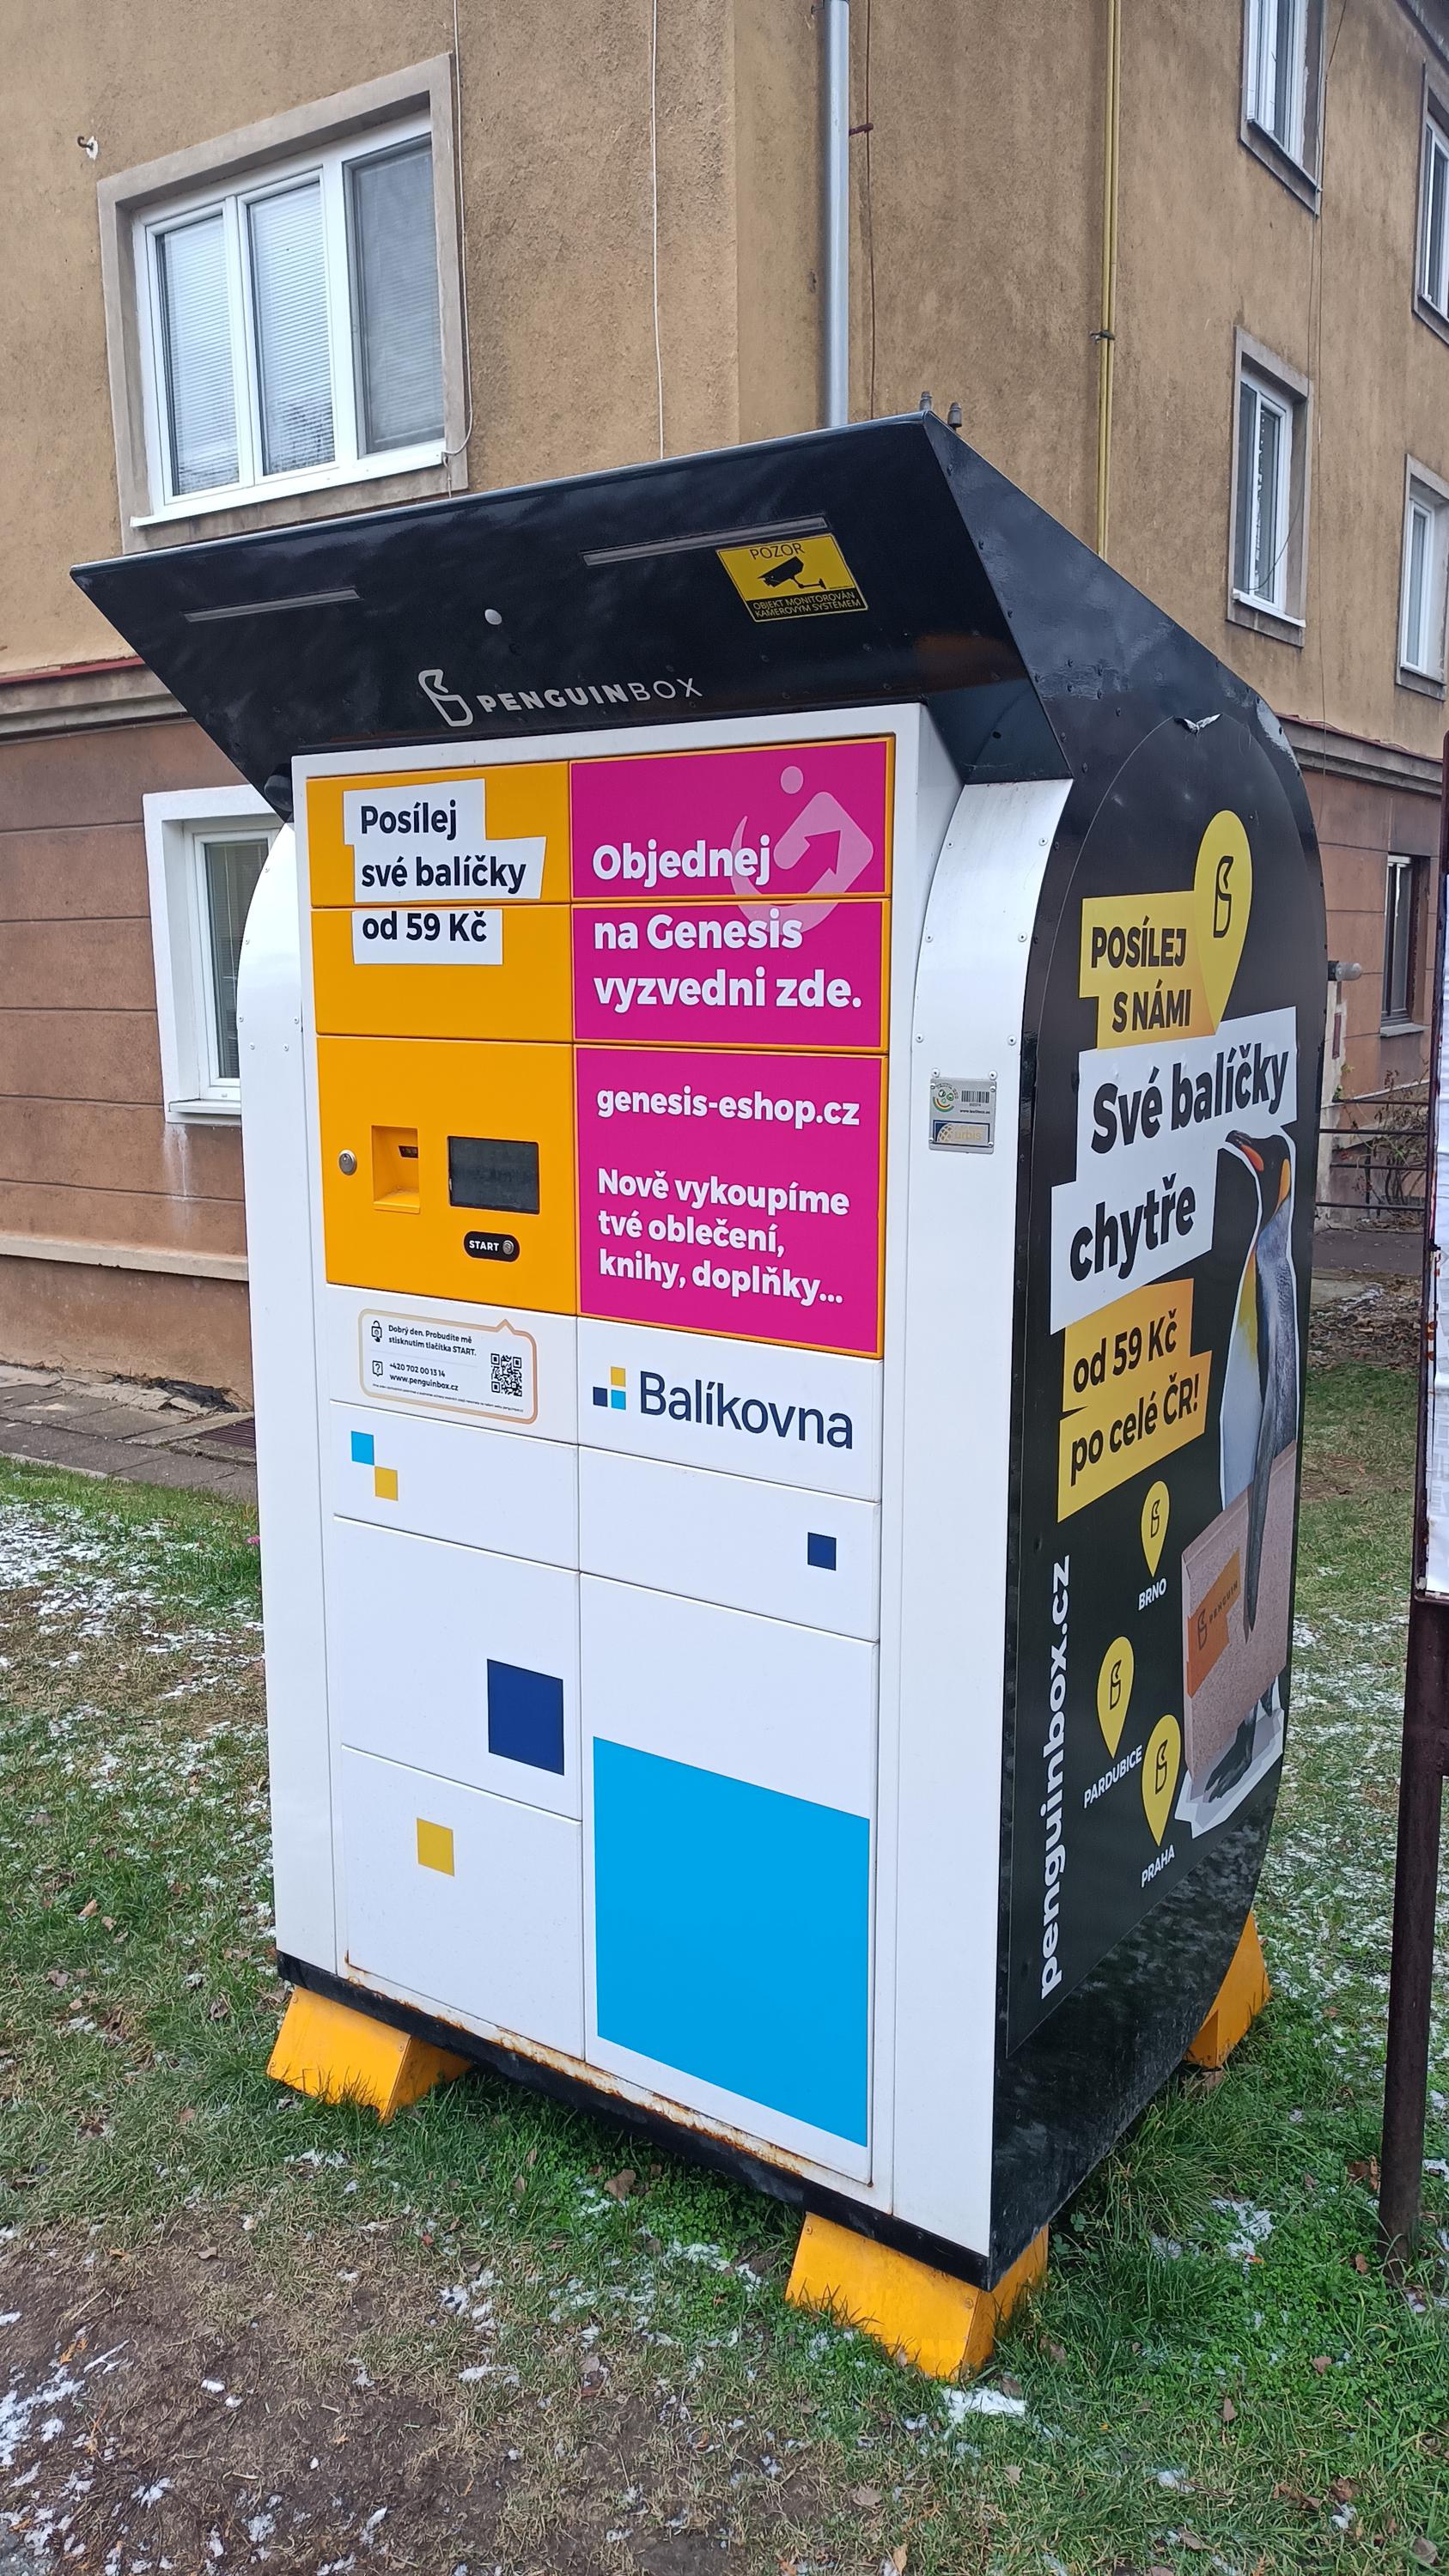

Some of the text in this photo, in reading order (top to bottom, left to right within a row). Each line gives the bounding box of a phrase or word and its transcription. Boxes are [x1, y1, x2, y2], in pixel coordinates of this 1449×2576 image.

[749, 542, 805, 561] POZOR
[752, 590, 855, 611] OBJEKT MONITOROVÁN
[476, 677, 703, 713] PENGUINBOX
[361, 799, 457, 841] Posílej
[362, 854, 527, 895] své balíčky
[592, 834, 770, 888] Objednej
[362, 910, 487, 942] od 59 Kč
[594, 908, 803, 950] na Genesis
[1091, 914, 1187, 969] POSÍLEJ
[594, 965, 862, 1013] vyzvedni zde.
[597, 1085, 860, 1130] genesis-eshop.cz
[1091, 1042, 1289, 1154] Své balíčky
[598, 1168, 850, 1216] Nově vykoupíme
[469, 1240, 500, 1252] START
[598, 1210, 785, 1258] tvé oblečení,
[1069, 1172, 1196, 1282] chytře
[600, 1248, 843, 1307] knihy, doplňky...
[388, 1324, 409, 1335] Dobrý
[409, 1327, 424, 1337] den.
[460, 1335, 472, 1344] mě
[388, 1336, 477, 1356] stisknutím tlačítka START.
[1073, 1308, 1178, 1394] od 59 Kč
[389, 1362, 405, 1371] +420
[406, 1364, 419, 1373] 702
[420, 1366, 429, 1375] 00
[437, 1370, 446, 1378] 14
[389, 1373, 459, 1391] www.penguinbox.cz
[640, 1370, 853, 1450] Balíkovna
[1070, 1371, 1200, 1487] po celé ČR!
[1137, 1577, 1167, 1611] BRNO
[1209, 1580, 1239, 1625] PENGUIN
[1040, 1554, 1070, 1999] penguinbox.cz
[1083, 1744, 1143, 1809] PARDUBICE
[1141, 1844, 1176, 1889] PRAHA
